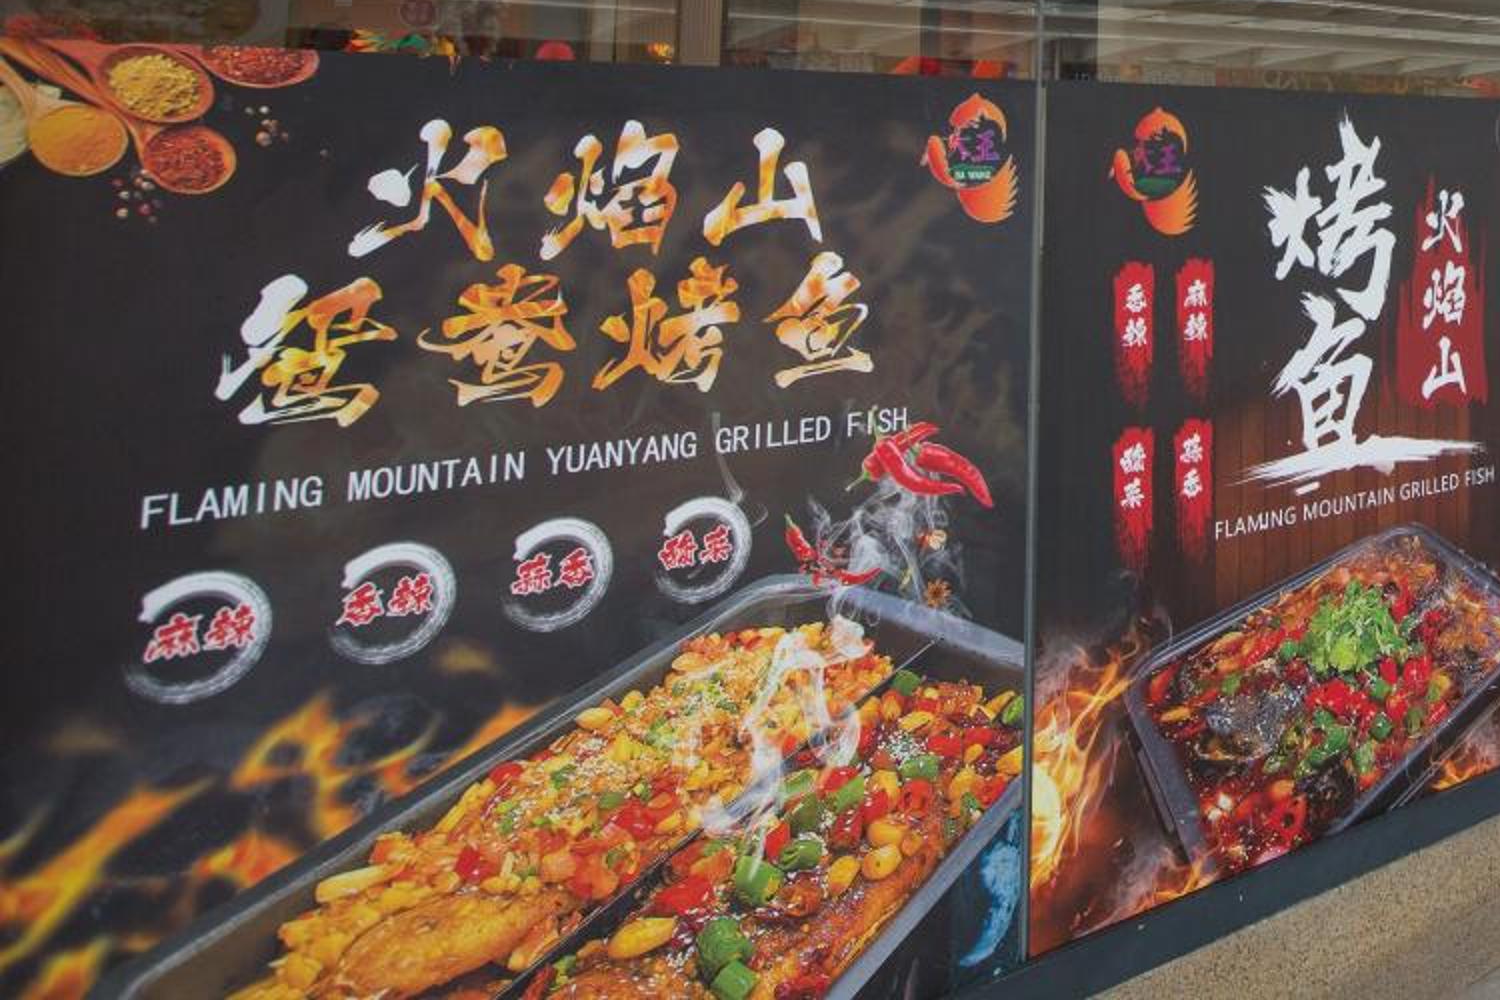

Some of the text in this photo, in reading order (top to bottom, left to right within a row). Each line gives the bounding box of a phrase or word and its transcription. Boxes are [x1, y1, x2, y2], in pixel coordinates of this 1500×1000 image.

[348, 118, 823, 262] 火焰山
[215, 251, 874, 427] 鸳鸯烤鱼
[1225, 106, 1488, 496] 烤鱼
[1421, 188, 1469, 401] 火焰山
[140, 404, 909, 530] FLAMING MOUNTAIN YUANYANG GRILLED FISH
[1215, 466, 1496, 541] FLAMING MOUNTAIN GRILLED FISH
[510, 547, 595, 596] 蒜香
[657, 524, 734, 571] 酸菜
[143, 600, 257, 664] 麻辣
[335, 571, 434, 627] 香辣
